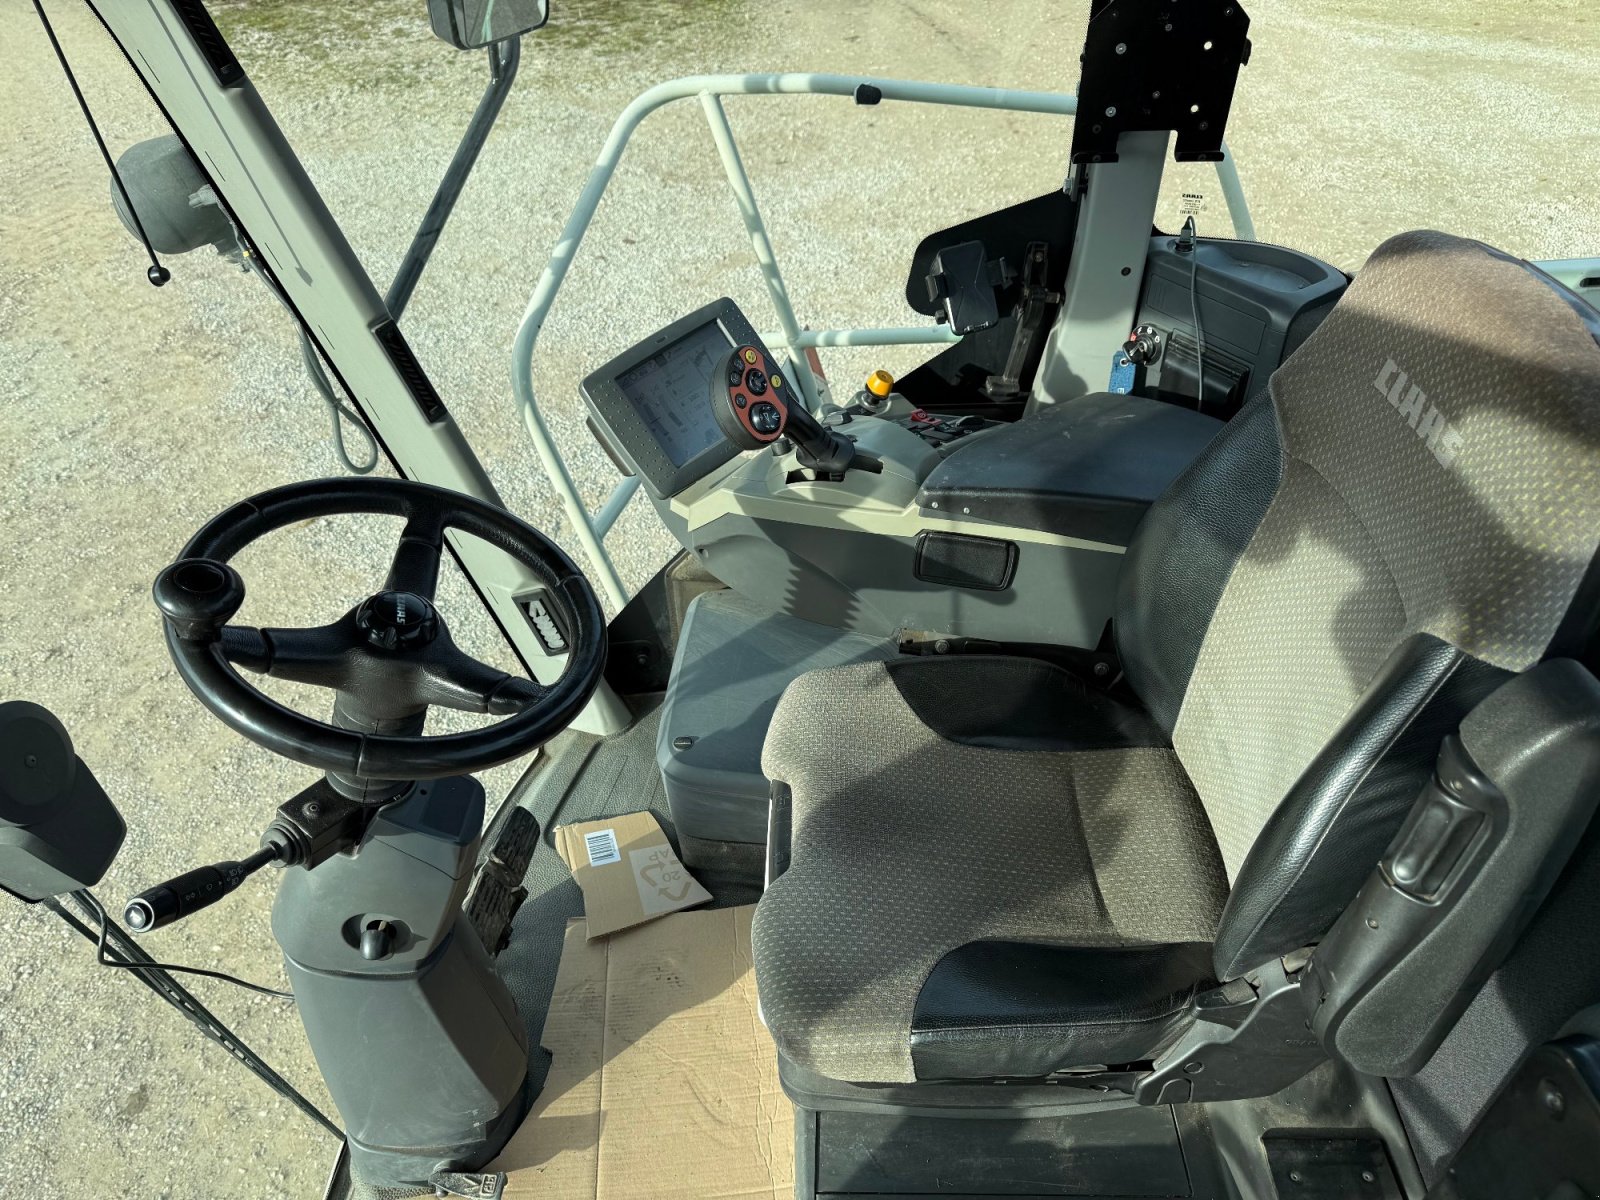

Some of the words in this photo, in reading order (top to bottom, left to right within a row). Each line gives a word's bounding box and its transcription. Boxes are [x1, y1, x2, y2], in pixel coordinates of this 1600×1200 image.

[1374, 358, 1464, 470] CLAAS
[649, 848, 670, 861] AP
[662, 870, 680, 882] 20
